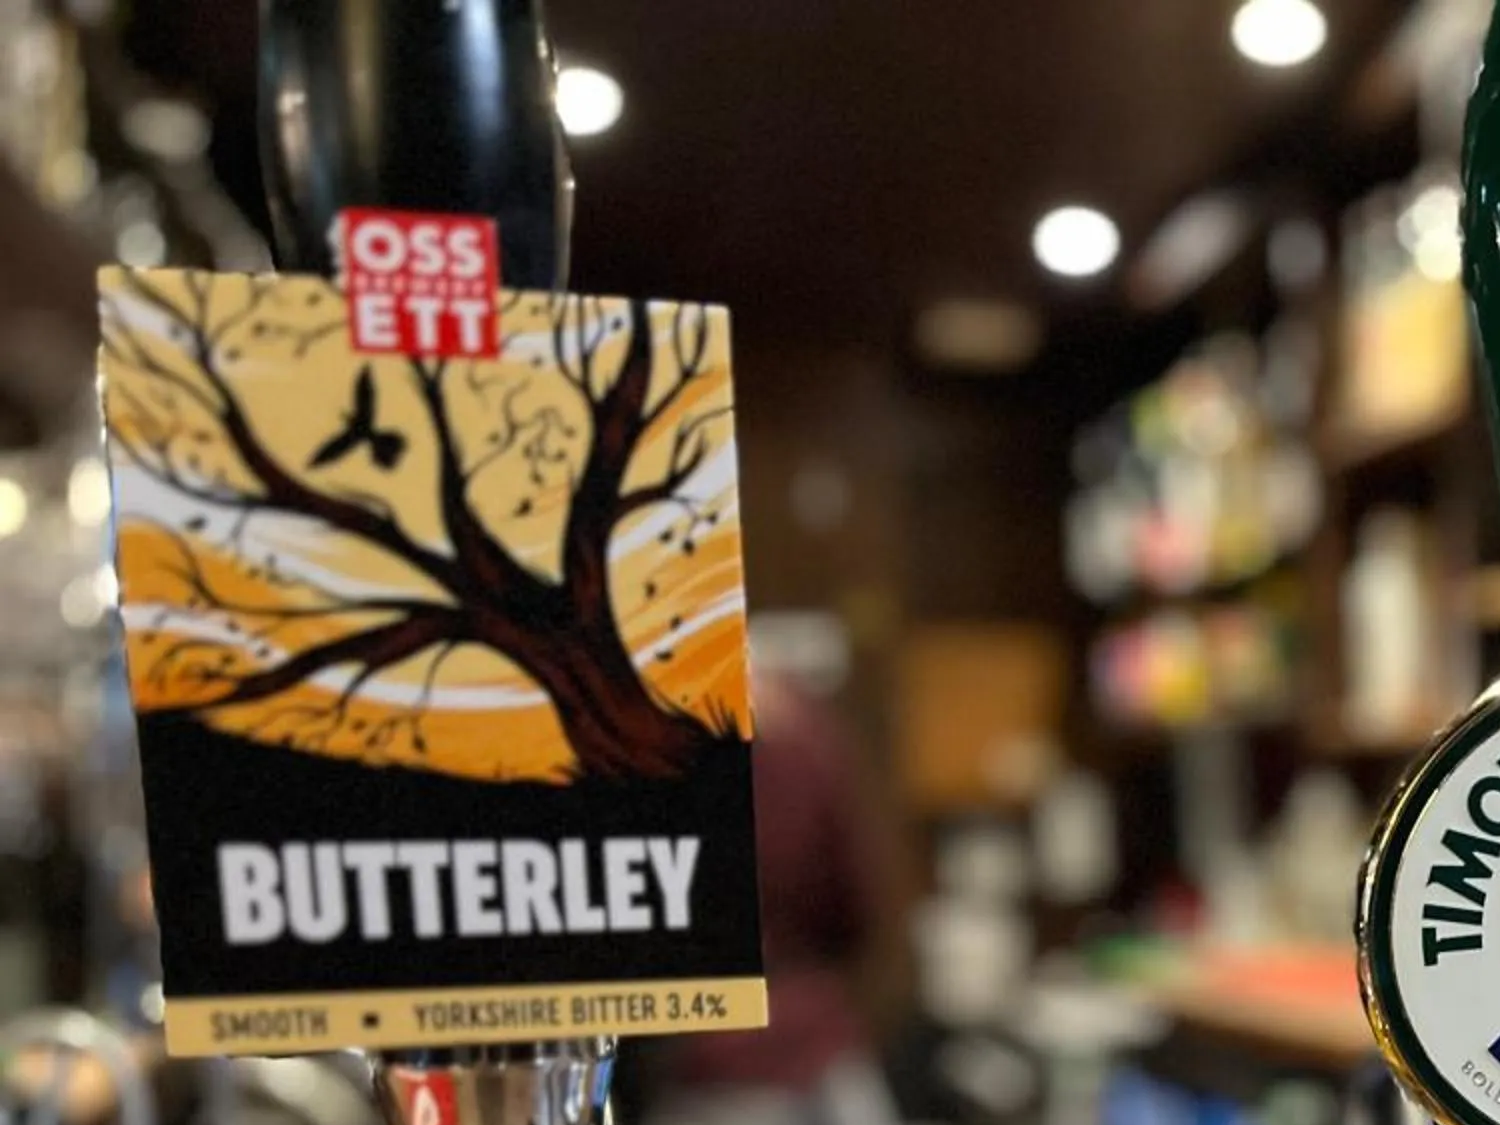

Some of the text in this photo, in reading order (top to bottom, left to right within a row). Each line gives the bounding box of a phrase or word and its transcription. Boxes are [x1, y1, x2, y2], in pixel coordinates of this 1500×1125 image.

[352, 218, 486, 278] OSS
[356, 295, 490, 353] ETT
[216, 836, 701, 945] BUTTERLEY
[210, 991, 728, 1045] SMOOTH YORKSHIRE BITTER 3.4%
